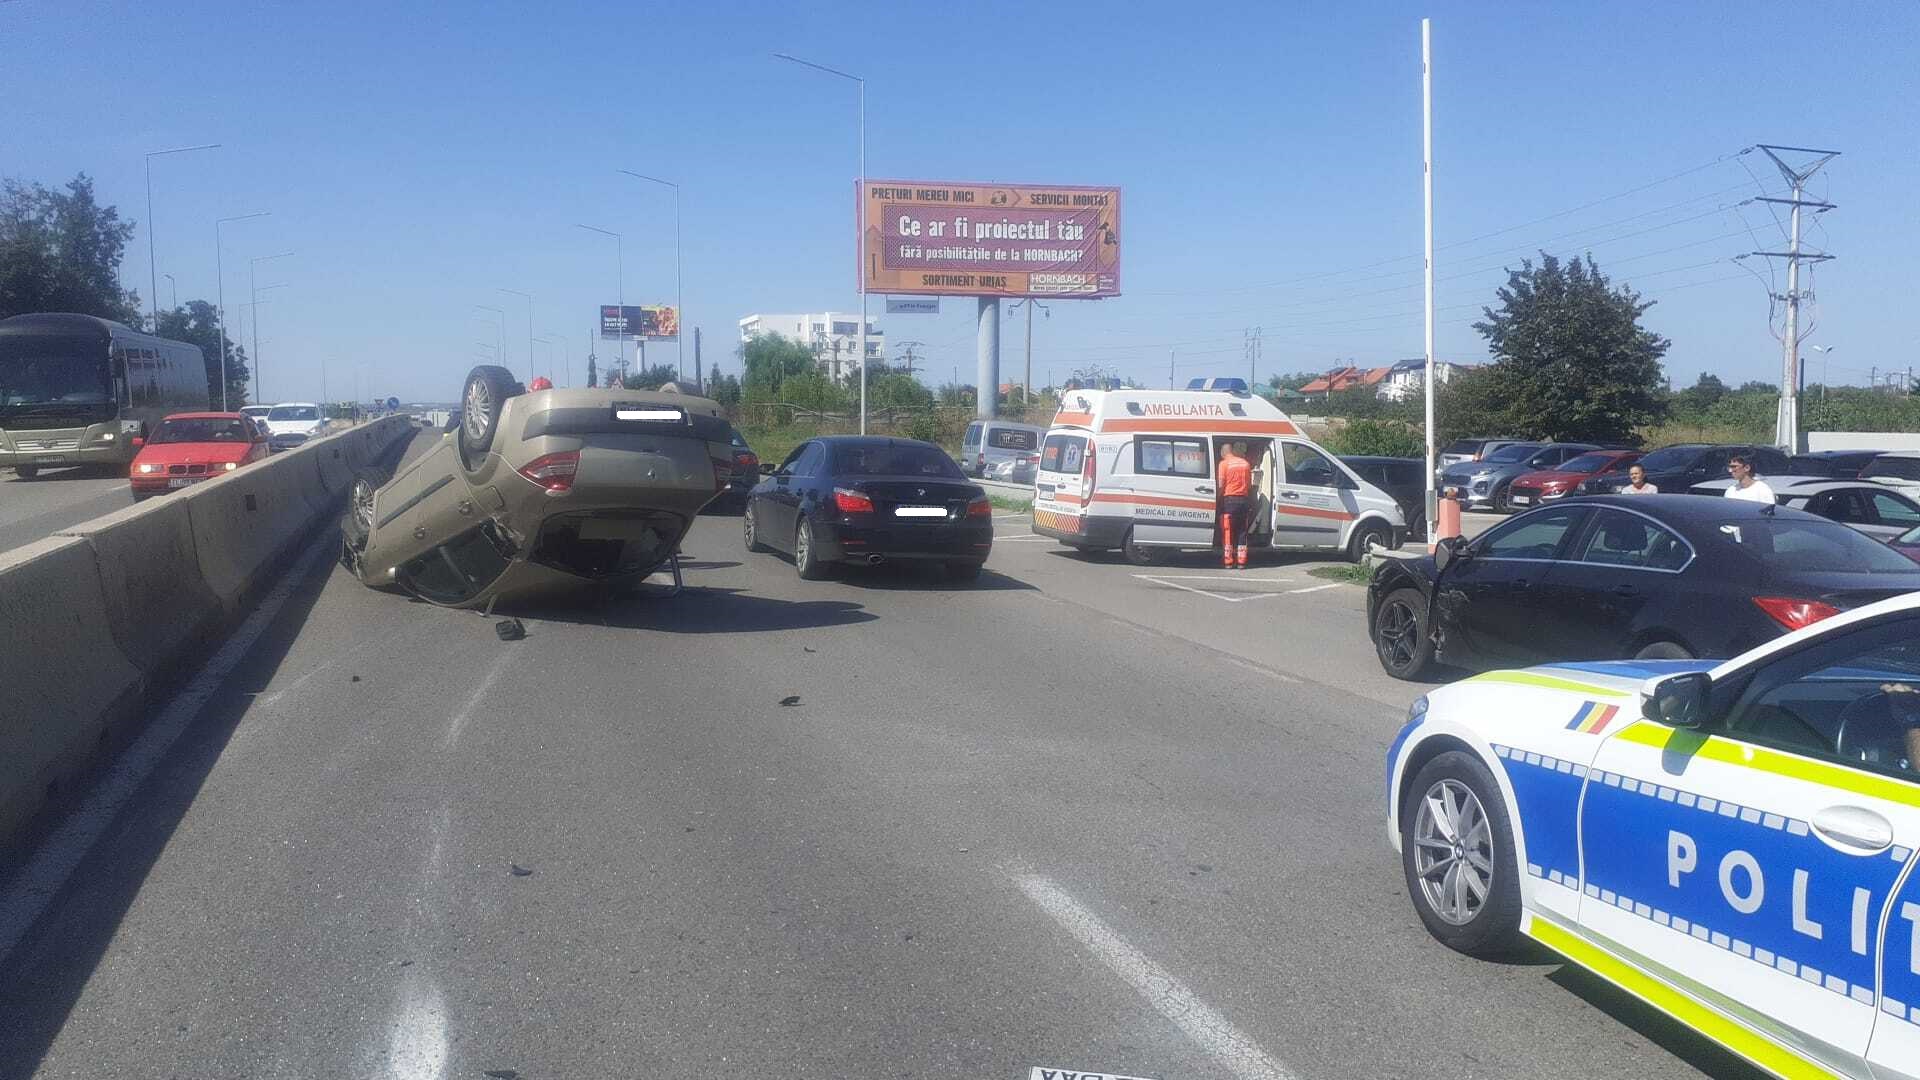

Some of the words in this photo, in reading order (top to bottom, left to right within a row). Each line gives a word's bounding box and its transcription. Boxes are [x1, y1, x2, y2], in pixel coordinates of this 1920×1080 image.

[916, 189, 949, 202] MEREU
[953, 190, 975, 203] MICI
[1030, 193, 1069, 206] SERVICII
[899, 215, 921, 237] Ce
[928, 220, 946, 237] ar
[954, 217, 968, 238] fi
[975, 218, 1050, 243] proiectul
[1057, 218, 1084, 241] tău
[900, 244, 922, 259] fără
[926, 246, 990, 263] posibilitățile
[994, 248, 1007, 261] de
[1010, 248, 1020, 261] la
[1024, 248, 1084, 262] HORNBACH?
[922, 273, 975, 287] SORTIMENT
[1030, 273, 1085, 284] HORNBACH
[1144, 403, 1224, 416] AMBULANTA
[1135, 508, 1165, 516] MEDICAL
[1167, 509, 1177, 517] DE
[1178, 511, 1210, 519] URGENTA
